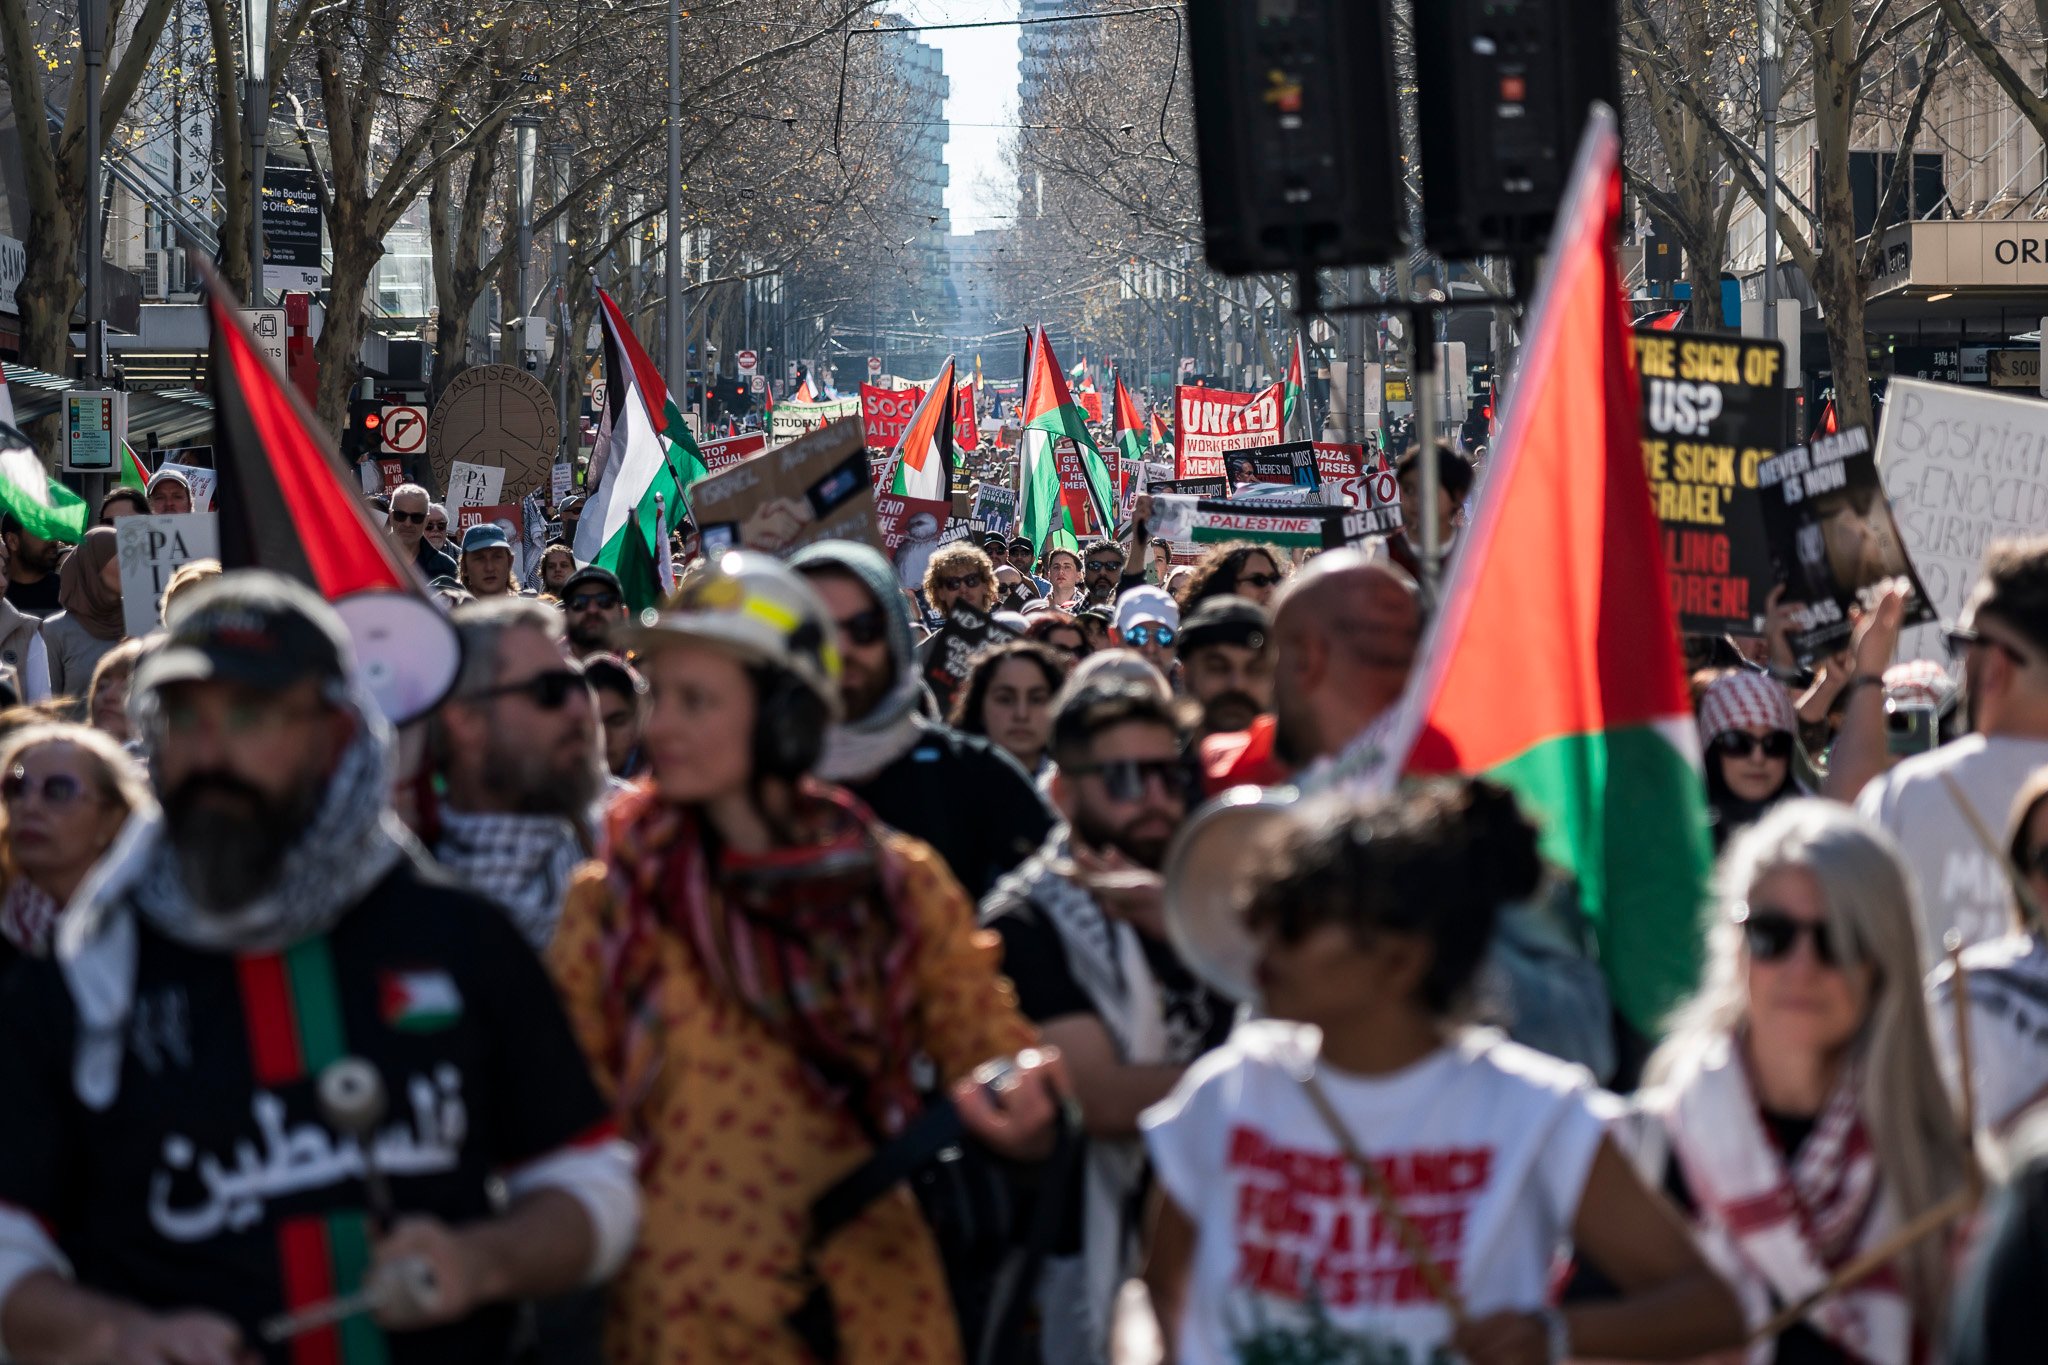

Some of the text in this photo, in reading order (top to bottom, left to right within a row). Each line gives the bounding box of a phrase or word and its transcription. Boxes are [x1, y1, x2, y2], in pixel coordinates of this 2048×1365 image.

[283, 189, 317, 201] Boutique
[262, 201, 268, 211] &
[270, 202, 295, 212] Office
[301, 272, 318, 285] Tiga
[1680, 342, 1741, 385] SICK
[1744, 346, 1779, 388] OF
[430, 366, 555, 431] NOT ANTISEMITIC
[1181, 397, 1277, 433] UNITED
[1650, 379, 1723, 437] US?
[1187, 435, 1275, 452] WORKERS UNION
[707, 453, 743, 468] EXUAL
[1061, 464, 1070, 473] IS
[1256, 463, 1291, 475] THERE'S NO
[1319, 461, 1356, 474] URSES
[1673, 441, 1736, 486] SICK
[1741, 447, 1776, 489] O
[1758, 446, 1810, 489] NEVER
[467, 470, 488, 487] PA
[500, 446, 554, 502] ENOCIDE
[464, 486, 486, 501] LE
[983, 488, 1003, 498] MARCH
[1206, 484, 1223, 497] MOST
[877, 499, 905, 516] END
[461, 512, 482, 526] END
[1208, 514, 1313, 532] PALESTINE
[1342, 505, 1403, 537] DEATH
[147, 530, 191, 560] PA
